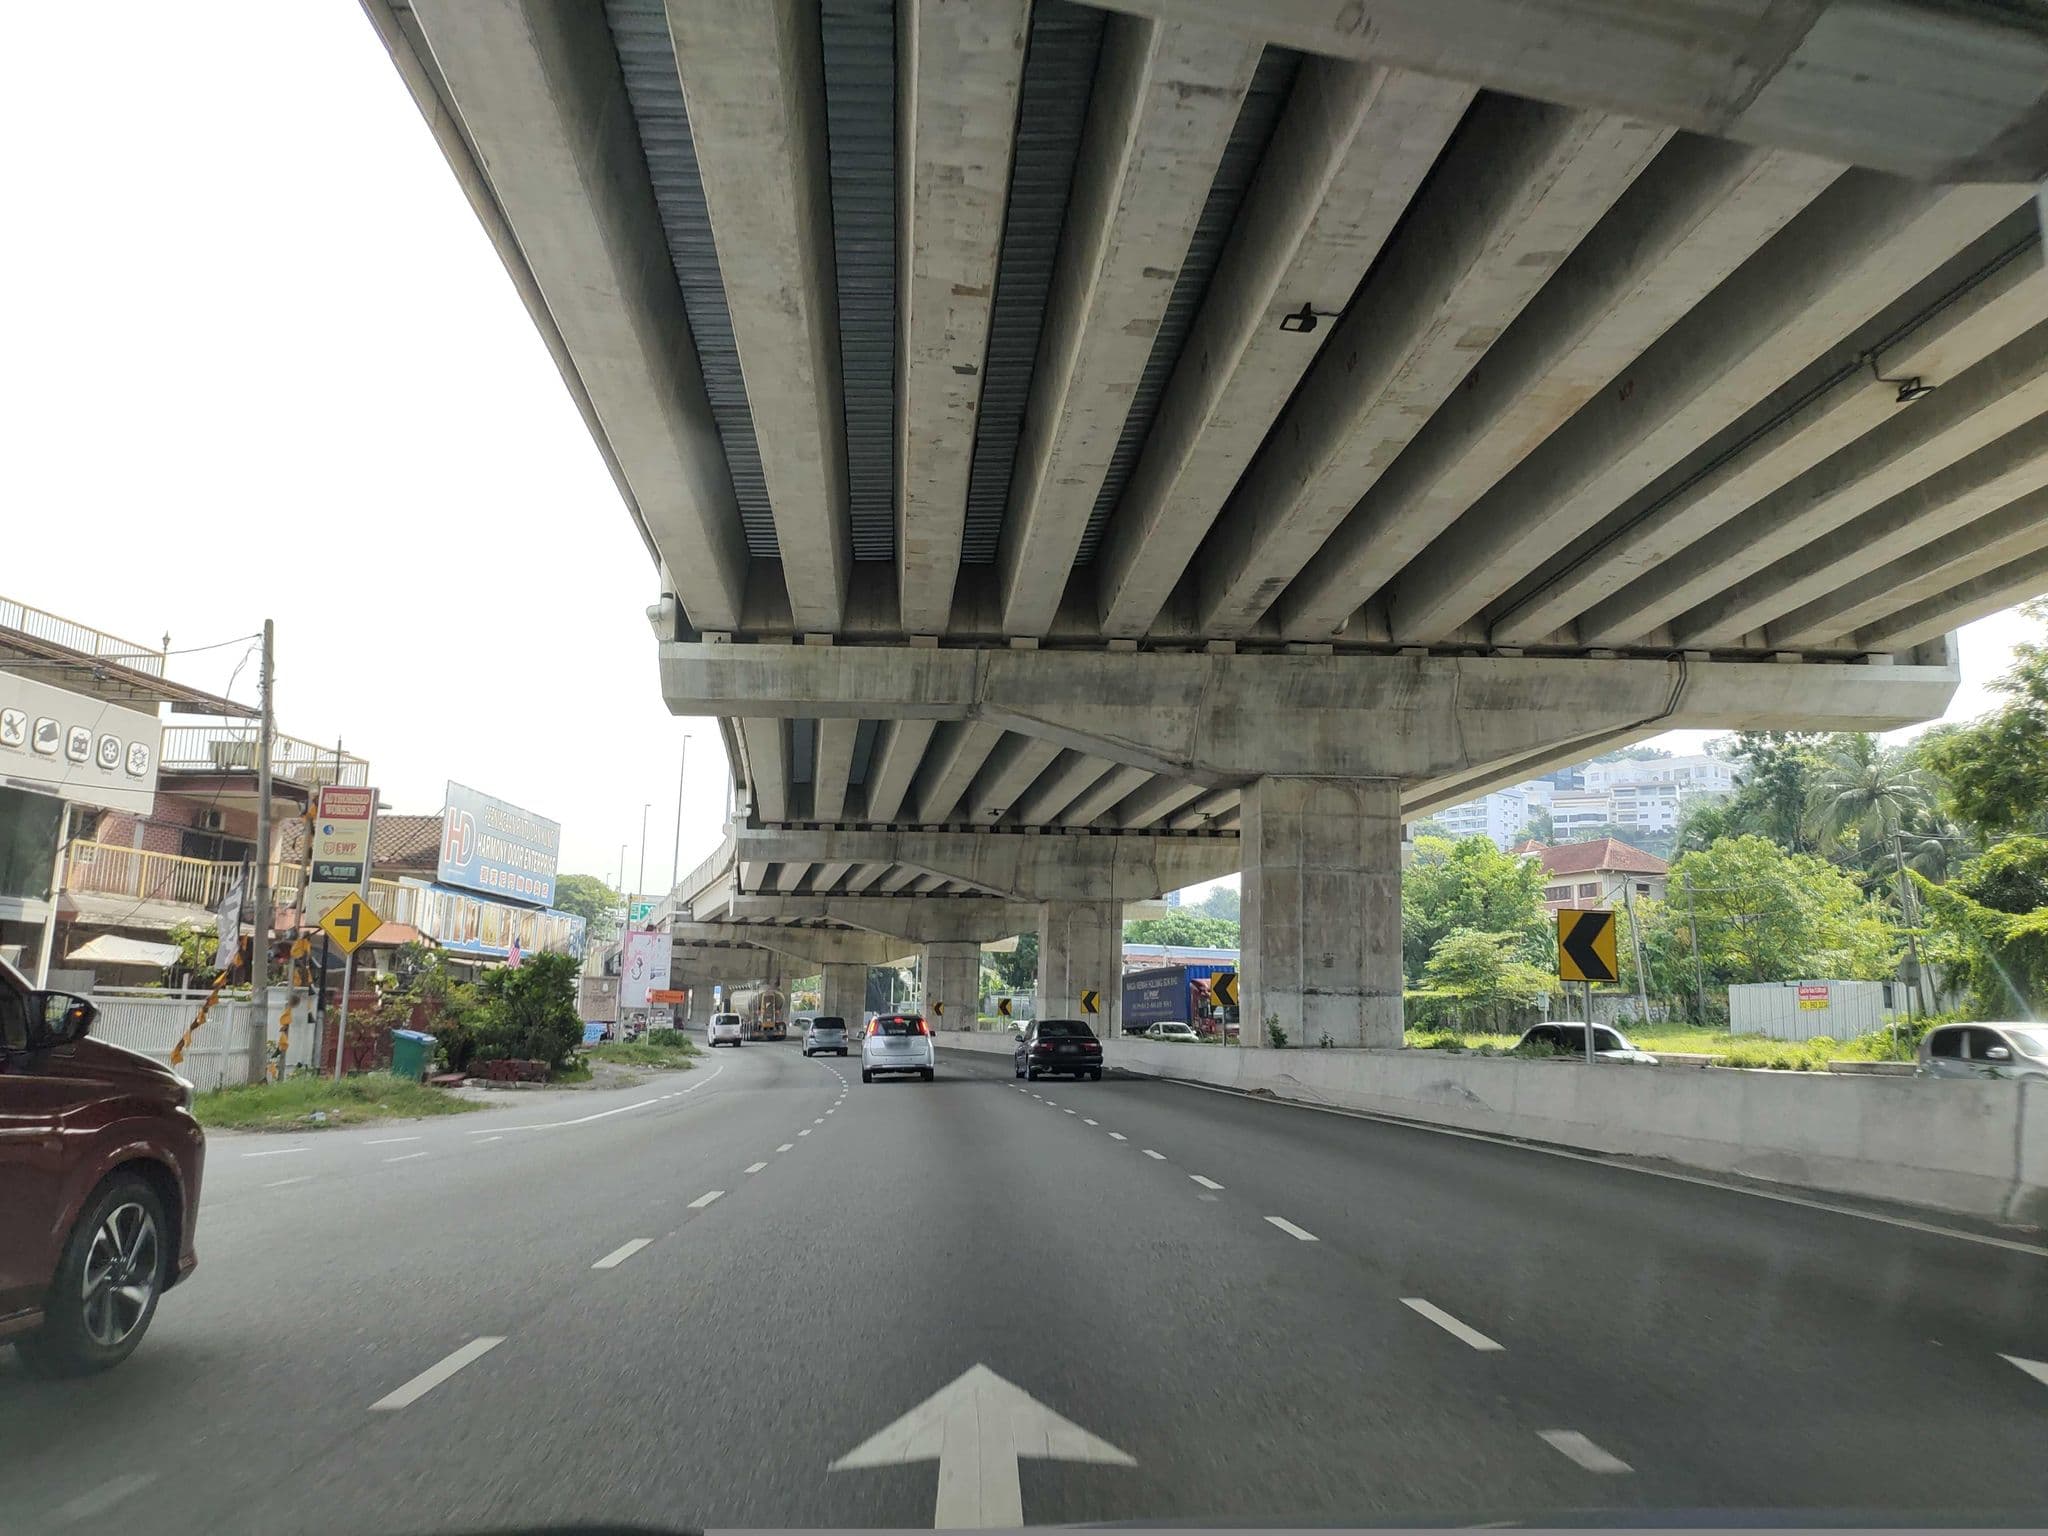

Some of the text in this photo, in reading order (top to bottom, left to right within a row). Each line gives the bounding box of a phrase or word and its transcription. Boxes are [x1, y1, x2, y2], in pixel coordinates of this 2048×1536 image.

[325, 804, 366, 816] WORKSHOP
[336, 842, 357, 852] EWP
[444, 806, 476, 867] HD
[477, 832, 556, 878] HARMONY DOOR ENTERPRISE
